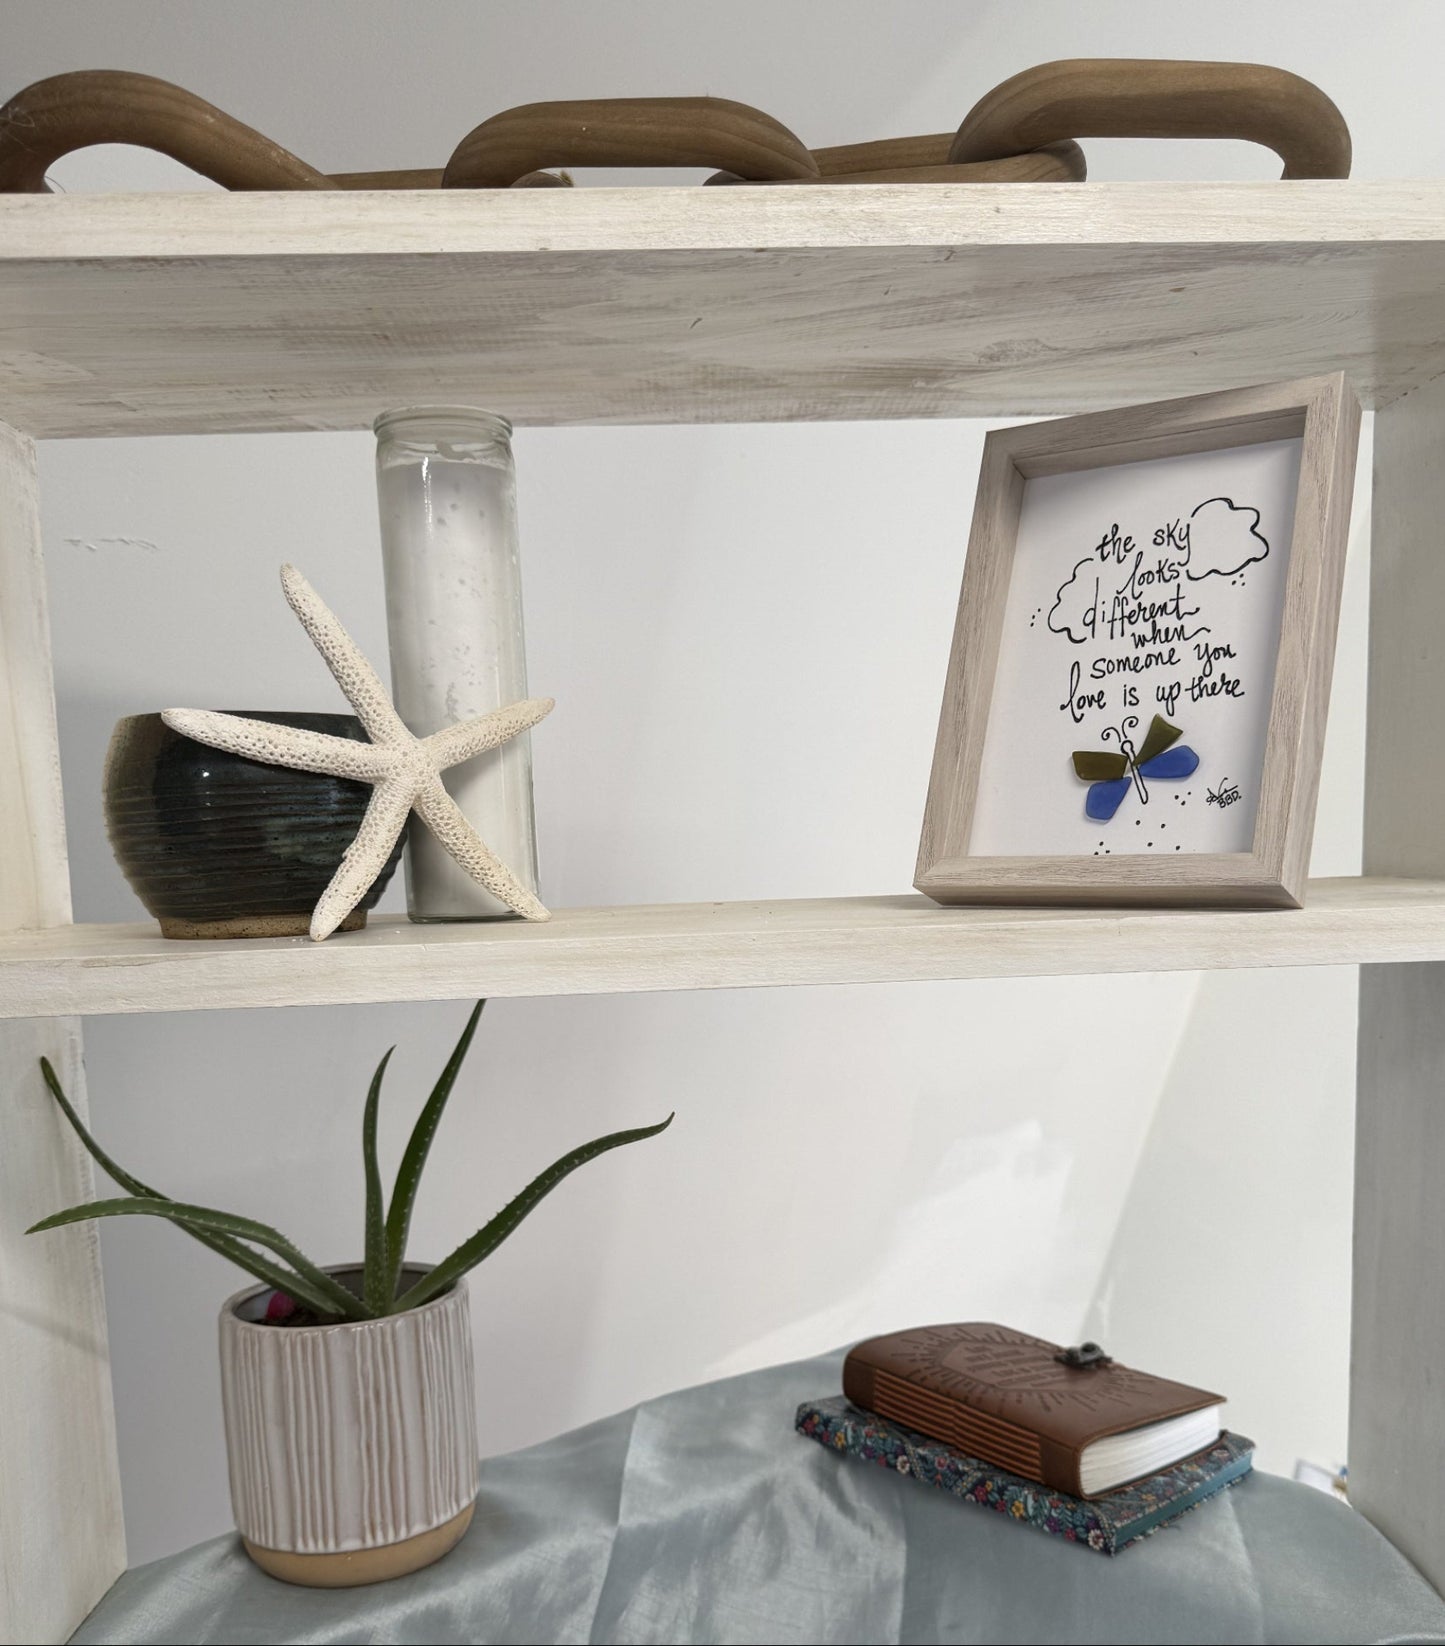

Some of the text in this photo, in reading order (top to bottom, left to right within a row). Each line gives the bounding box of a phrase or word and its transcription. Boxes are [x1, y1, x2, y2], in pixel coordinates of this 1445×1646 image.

[1095, 523, 1136, 563] the
[1082, 576, 1201, 640] different
[1131, 620, 1211, 649] when
[1090, 647, 1181, 679] someone
[1060, 661, 1107, 723] love
[1123, 684, 1140, 707] is
